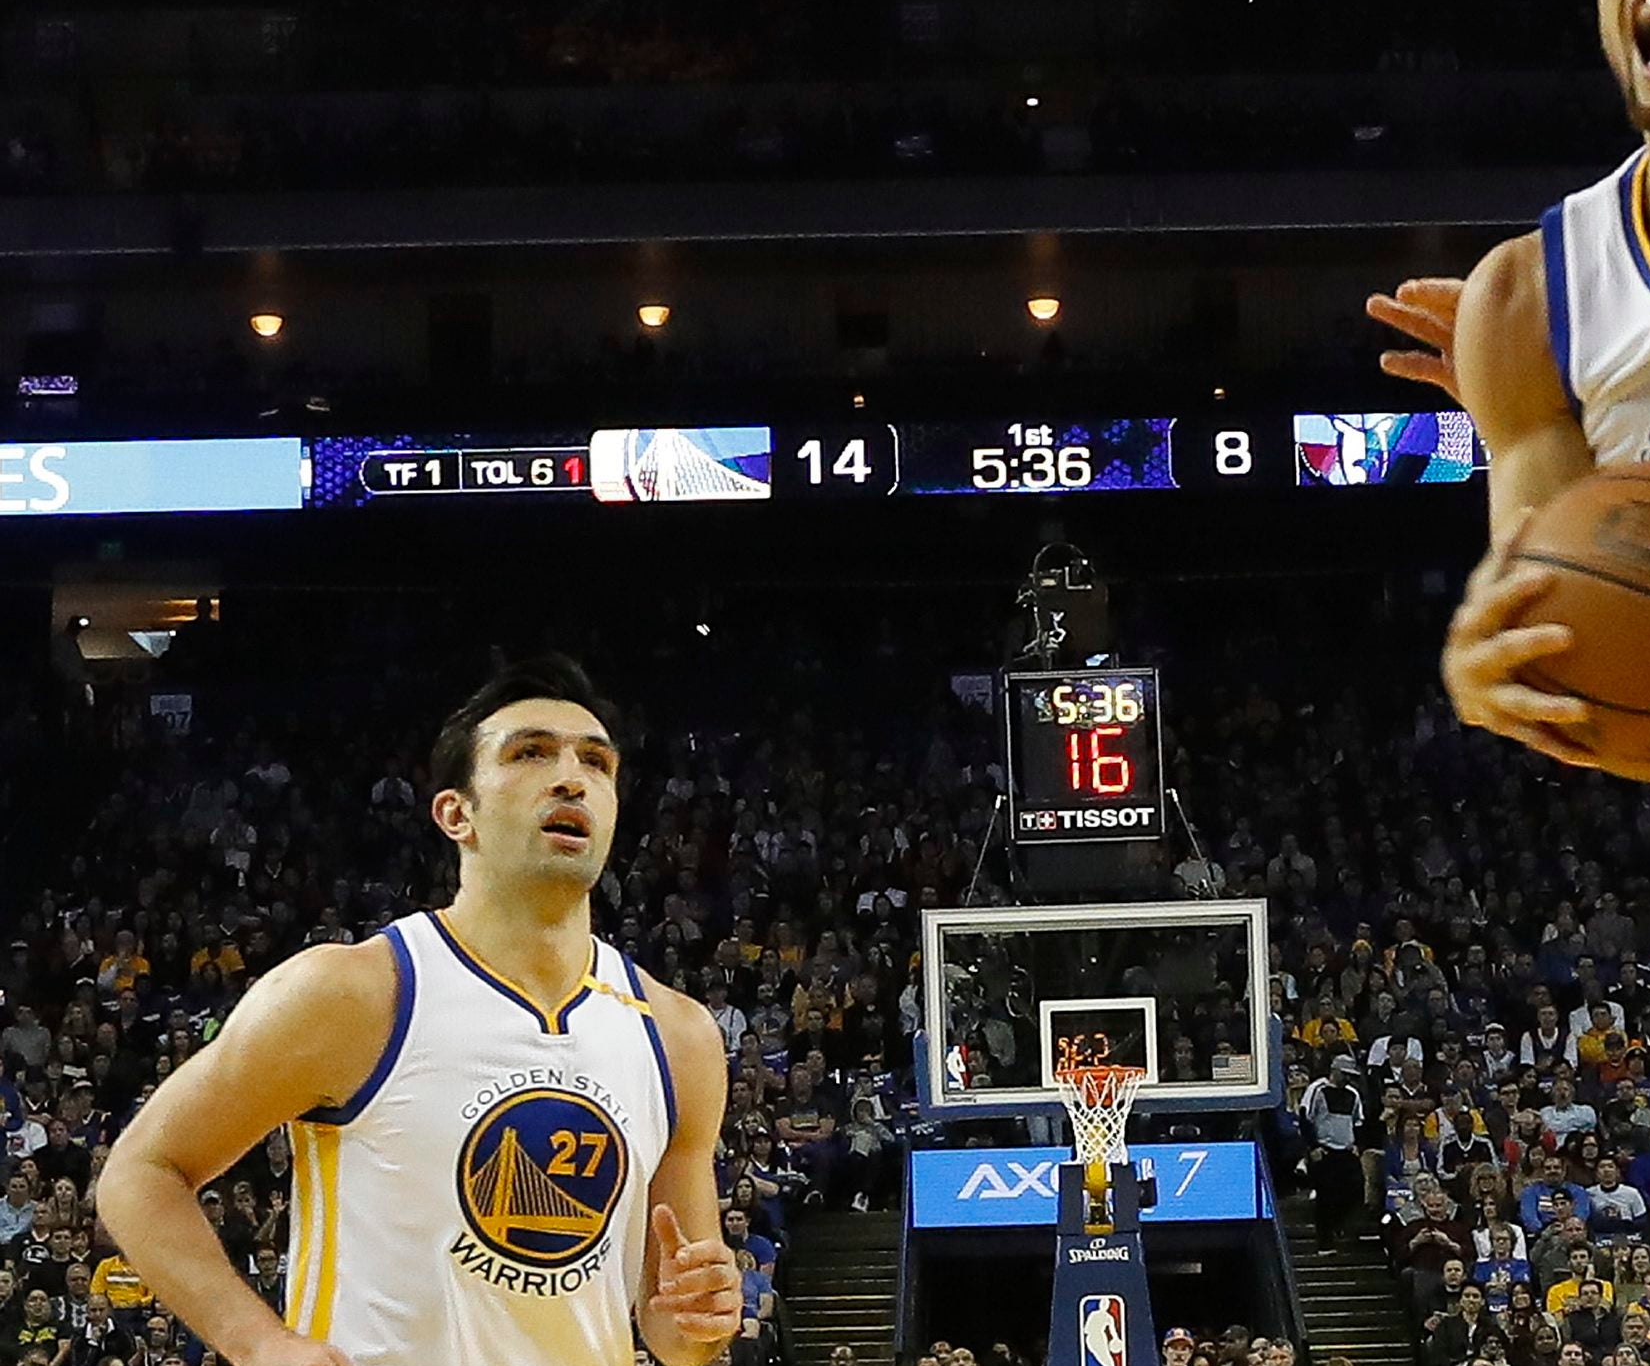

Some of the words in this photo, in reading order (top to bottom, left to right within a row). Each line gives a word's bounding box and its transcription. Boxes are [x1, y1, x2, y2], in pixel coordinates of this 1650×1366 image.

[1008, 425, 1053, 446] 1st
[1215, 432, 1252, 475] 8
[384, 462, 417, 487] TF
[424, 458, 441, 486] 1
[471, 461, 524, 486] TOL
[531, 458, 554, 484] 6
[798, 440, 871, 484] 14
[973, 447, 1092, 489] 5:36
[1053, 683, 1138, 724] 5:36
[1070, 726, 1129, 794] 16
[1059, 808, 1154, 828] TISSOT
[461, 1068, 563, 1120] GOLDEN
[547, 1130, 609, 1177] 27
[1174, 1150, 1208, 1197] 7
[451, 1231, 611, 1296] WARRIORS
[1069, 1246, 1129, 1263] SPALDING
